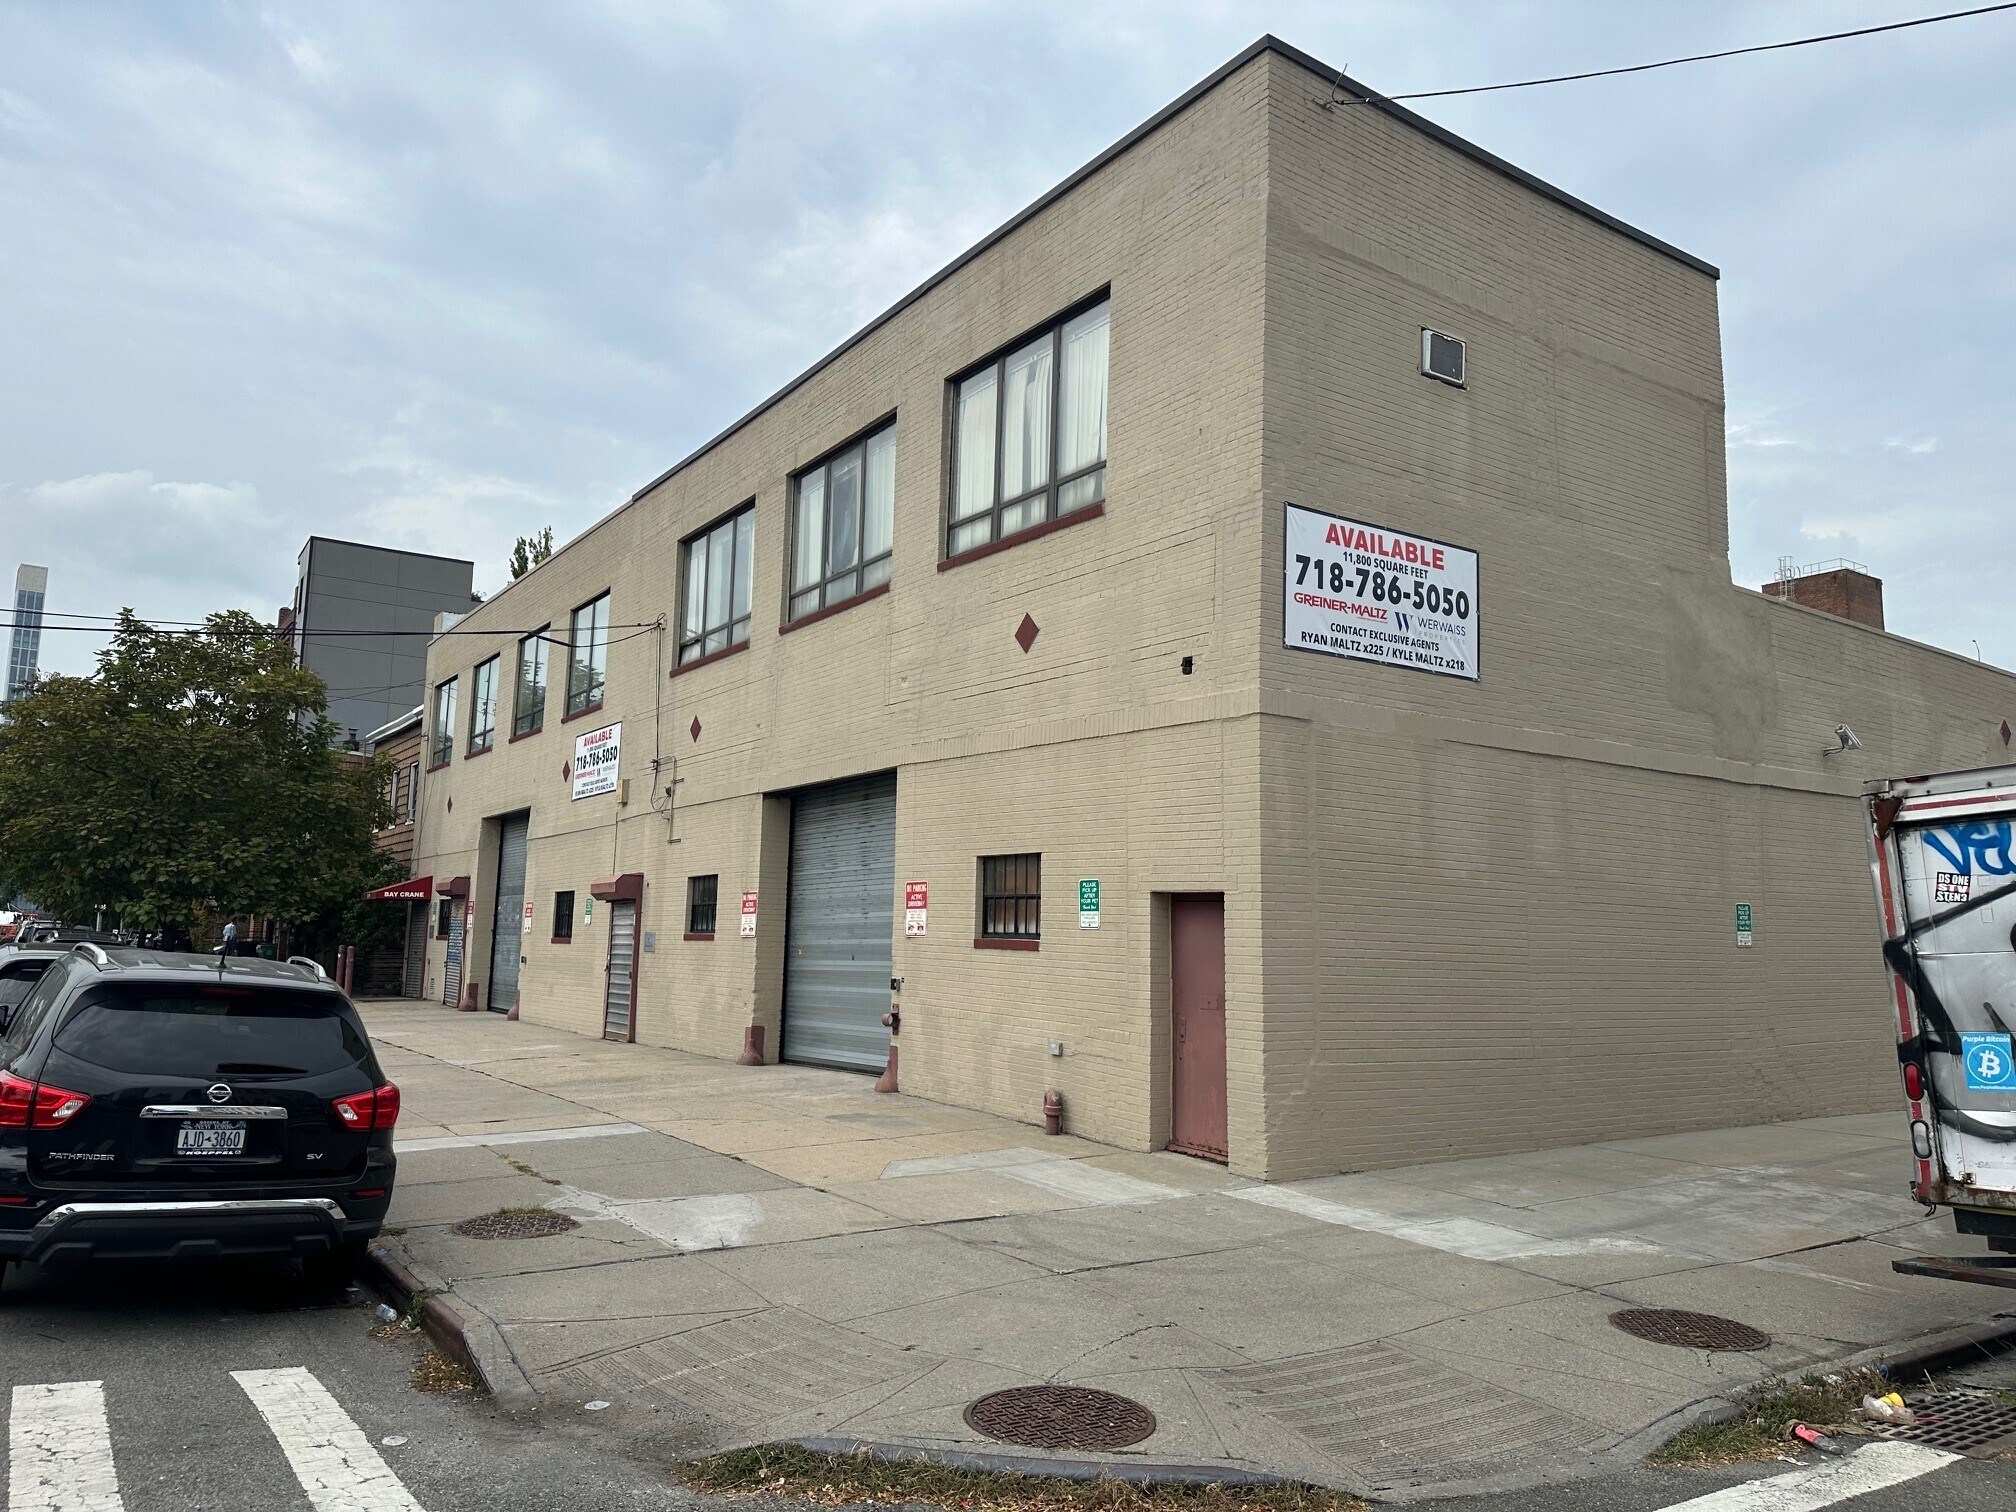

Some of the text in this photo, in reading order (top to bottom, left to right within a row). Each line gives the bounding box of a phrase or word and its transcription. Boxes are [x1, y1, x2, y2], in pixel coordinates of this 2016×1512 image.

[1325, 522, 1444, 570] AVAILABLE
[1343, 551, 1428, 580] 11,800 SQUARE FEET
[1296, 554, 1470, 620] 718-786-5050
[1294, 592, 1388, 620] GREINER-MALTZ
[1330, 622, 1440, 652] CONTACT EXCLUSIVE AGENTS
[1417, 616, 1466, 637] WERWAISS
[1301, 631, 1328, 646] RYAN
[1330, 636, 1362, 652] MALTZ
[1363, 643, 1384, 656] x225
[1392, 648, 1414, 661] KYLE
[1416, 652, 1444, 667] MALTZ
[1446, 658, 1465, 671] x218
[583, 728, 612, 747] AVAILABLE
[576, 745, 618, 772] 718-786-5050
[1937, 884, 1968, 893] STV
[1938, 873, 1969, 885] DS ONE
[1935, 892, 1967, 903] STEN3
[182, 1131, 240, 1147] AJD 3860
[49, 1152, 115, 1160] PATHFINDER
